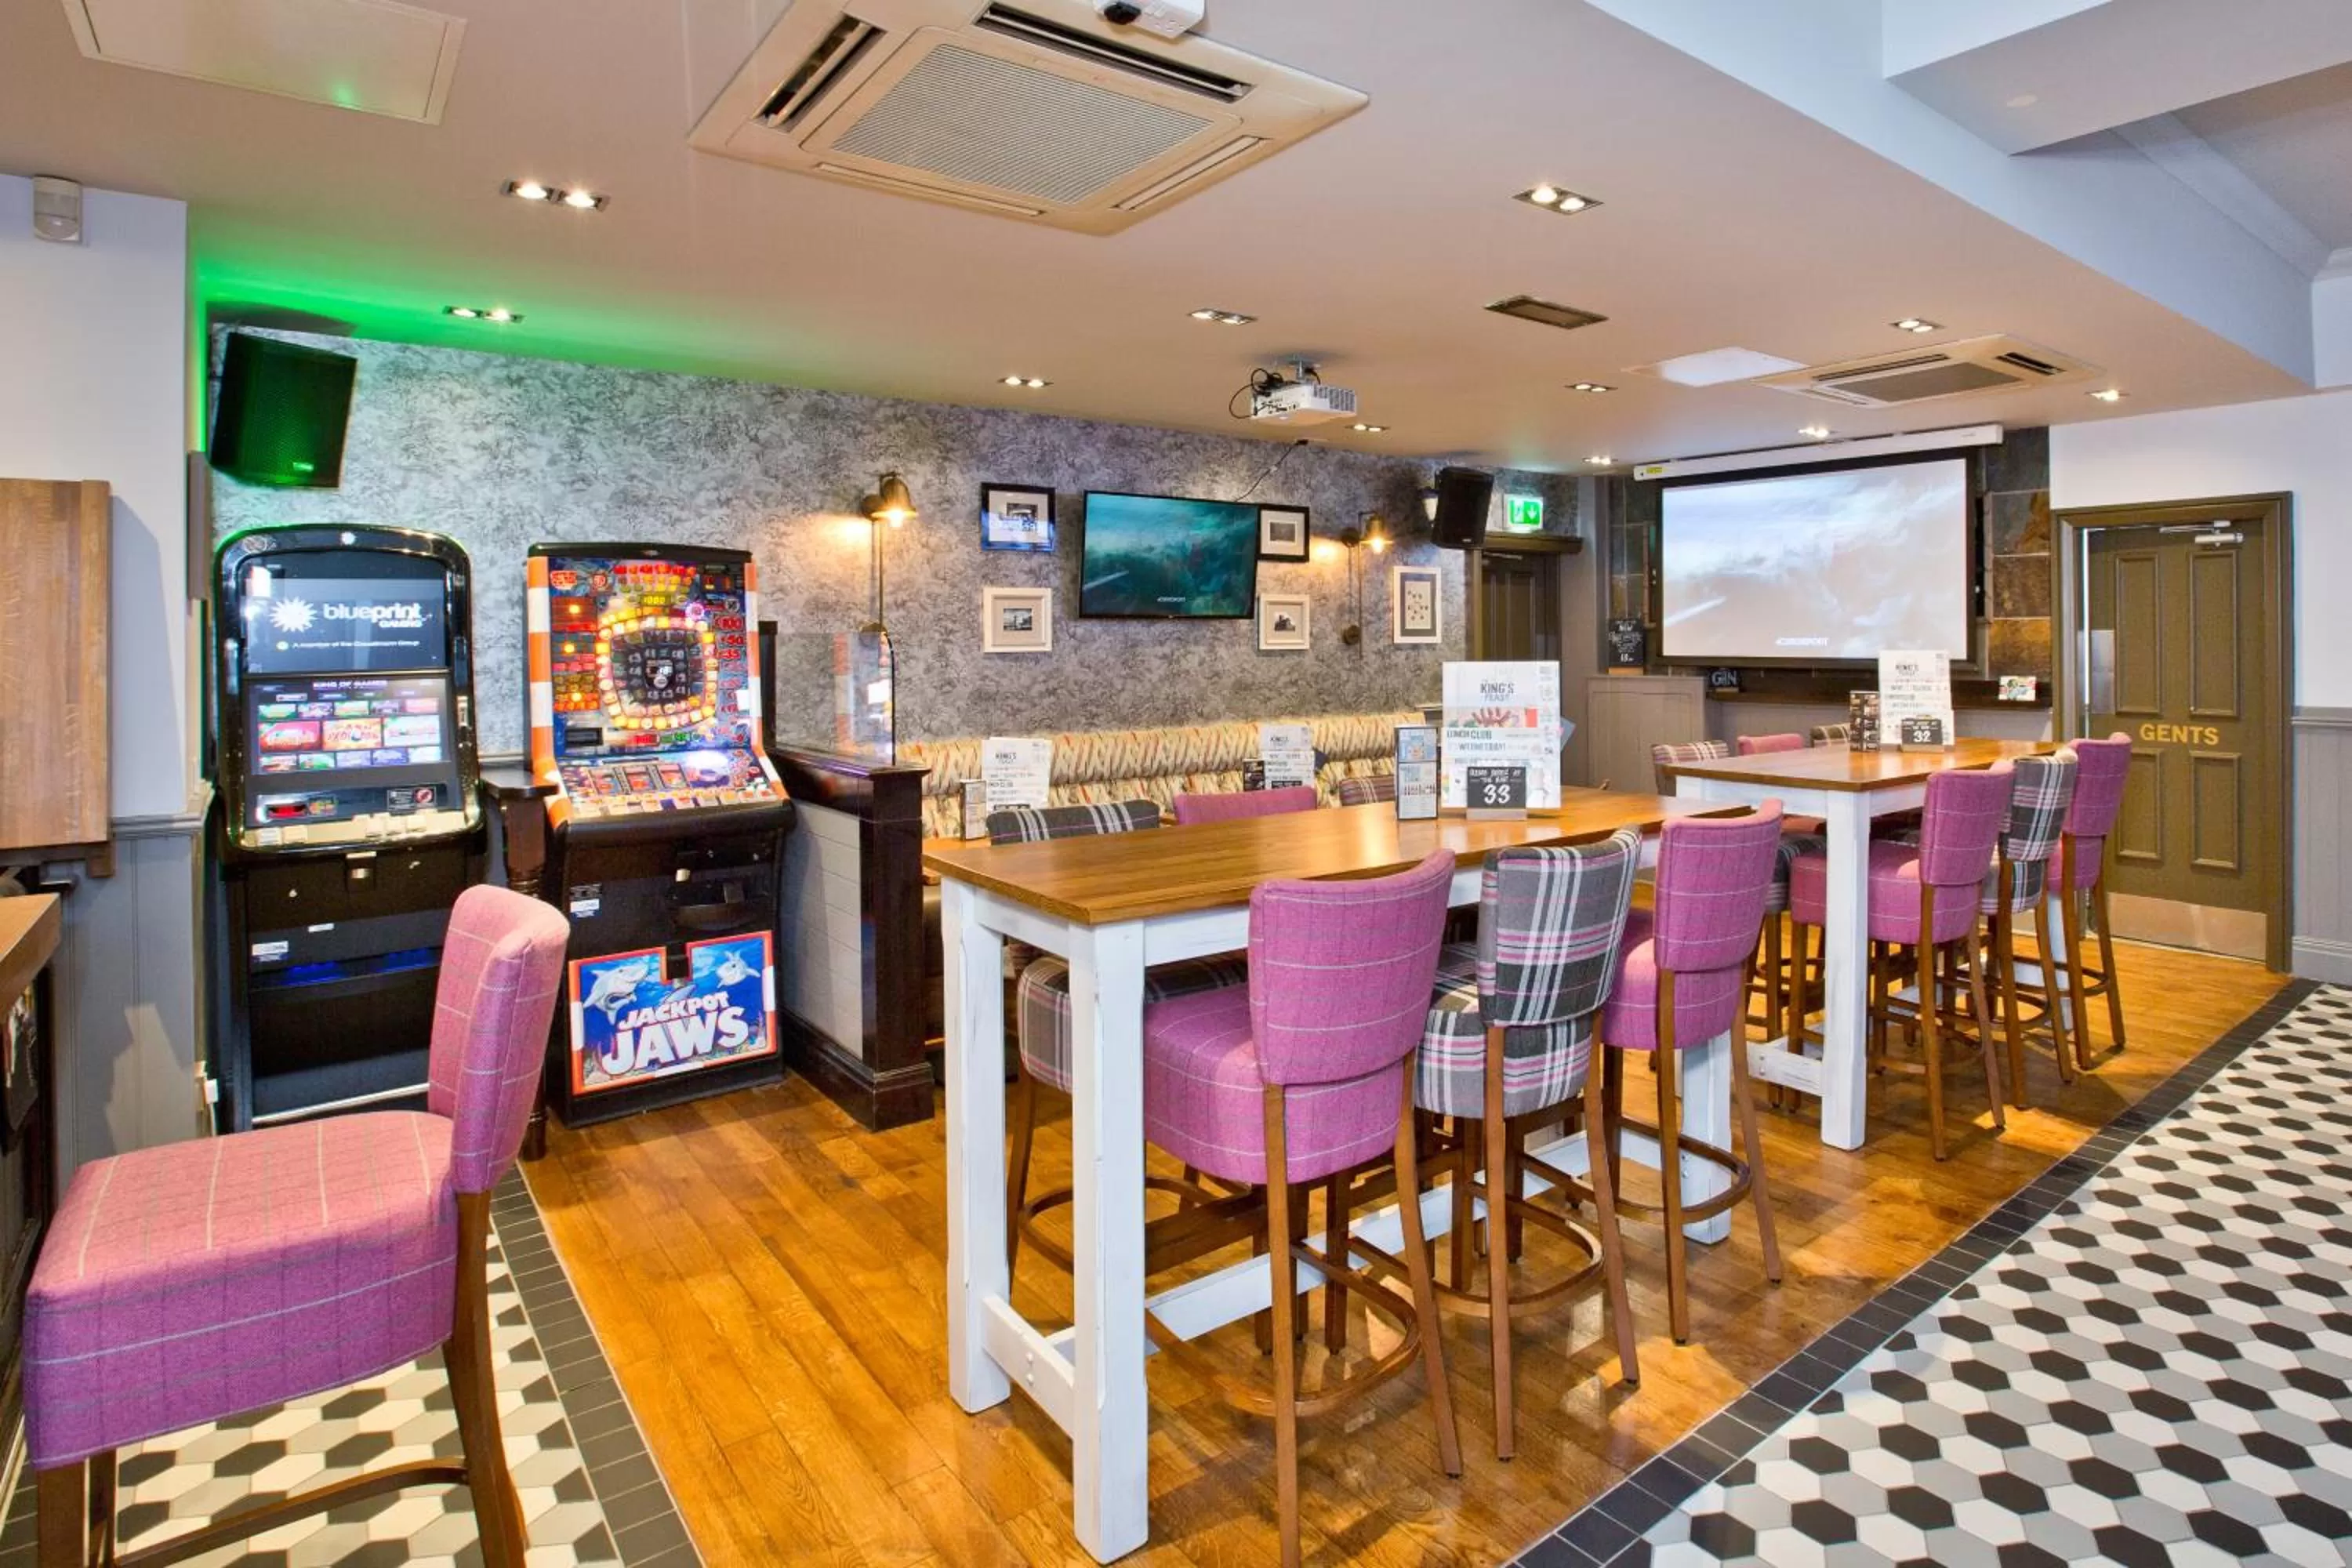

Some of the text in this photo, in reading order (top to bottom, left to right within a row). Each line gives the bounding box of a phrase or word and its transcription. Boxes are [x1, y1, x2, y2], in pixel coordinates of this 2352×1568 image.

[322, 602, 422, 623] blueprint
[1479, 683, 1515, 694] KING'S
[1711, 670, 1737, 686] GIN
[1914, 730, 1932, 742] 32
[2139, 724, 2220, 746] GENTS
[1483, 783, 1512, 804] 33
[618, 991, 729, 1029] JACKPOT
[601, 1006, 749, 1075] JAWS
